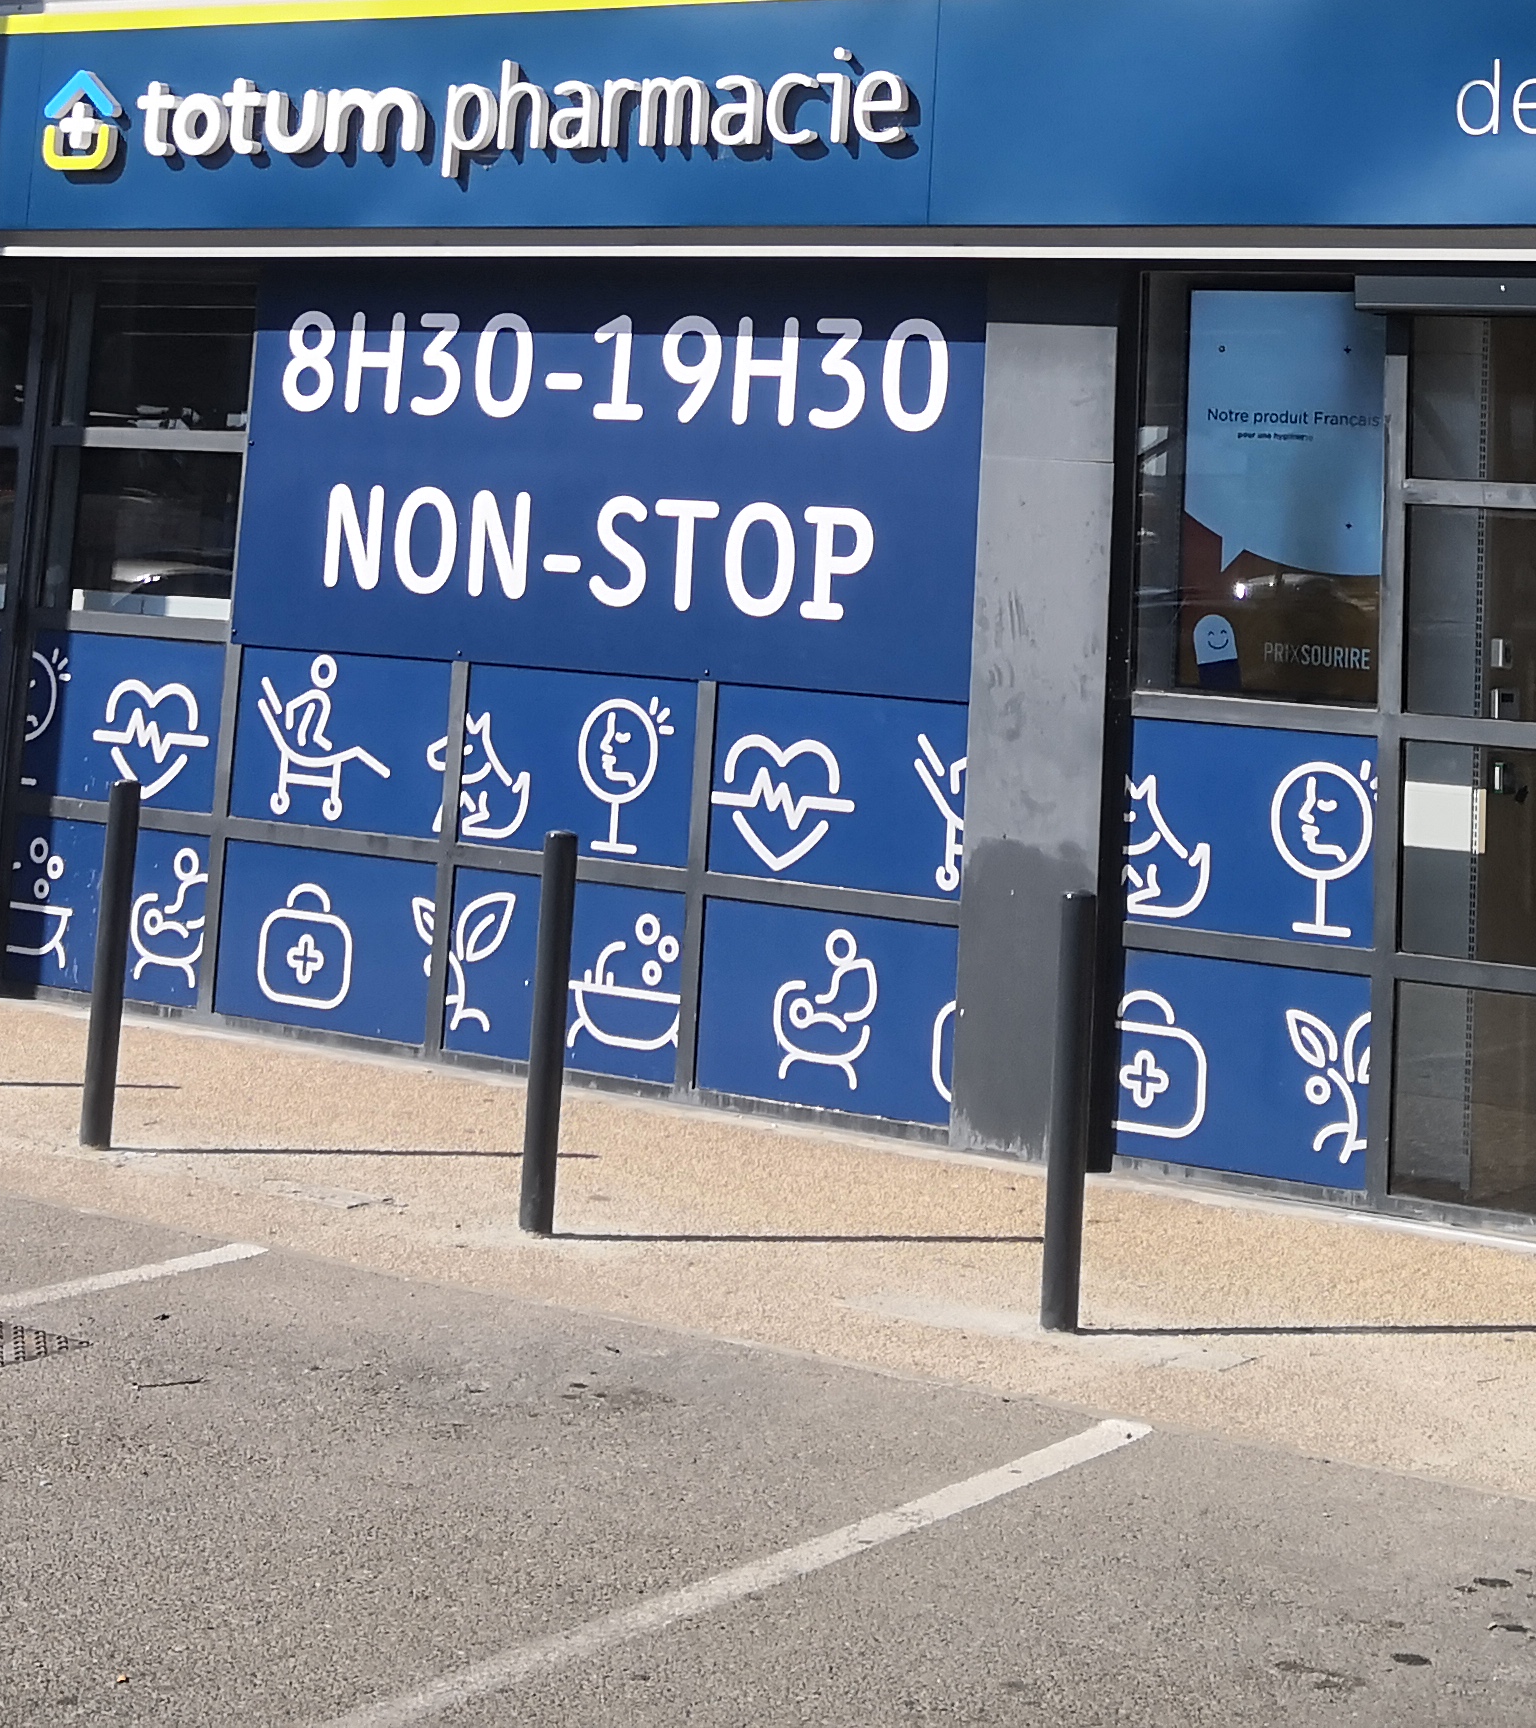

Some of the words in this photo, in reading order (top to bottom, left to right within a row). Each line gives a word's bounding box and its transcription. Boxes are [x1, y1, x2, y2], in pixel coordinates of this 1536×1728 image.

[137, 75, 432, 158] totum
[440, 45, 914, 180] pharmacie
[281, 309, 950, 433] 8H30-19H30
[1207, 408, 1249, 423] Notre
[1253, 410, 1308, 425] produit
[1313, 411, 1382, 427] Français
[322, 482, 876, 622] NON-STOP
